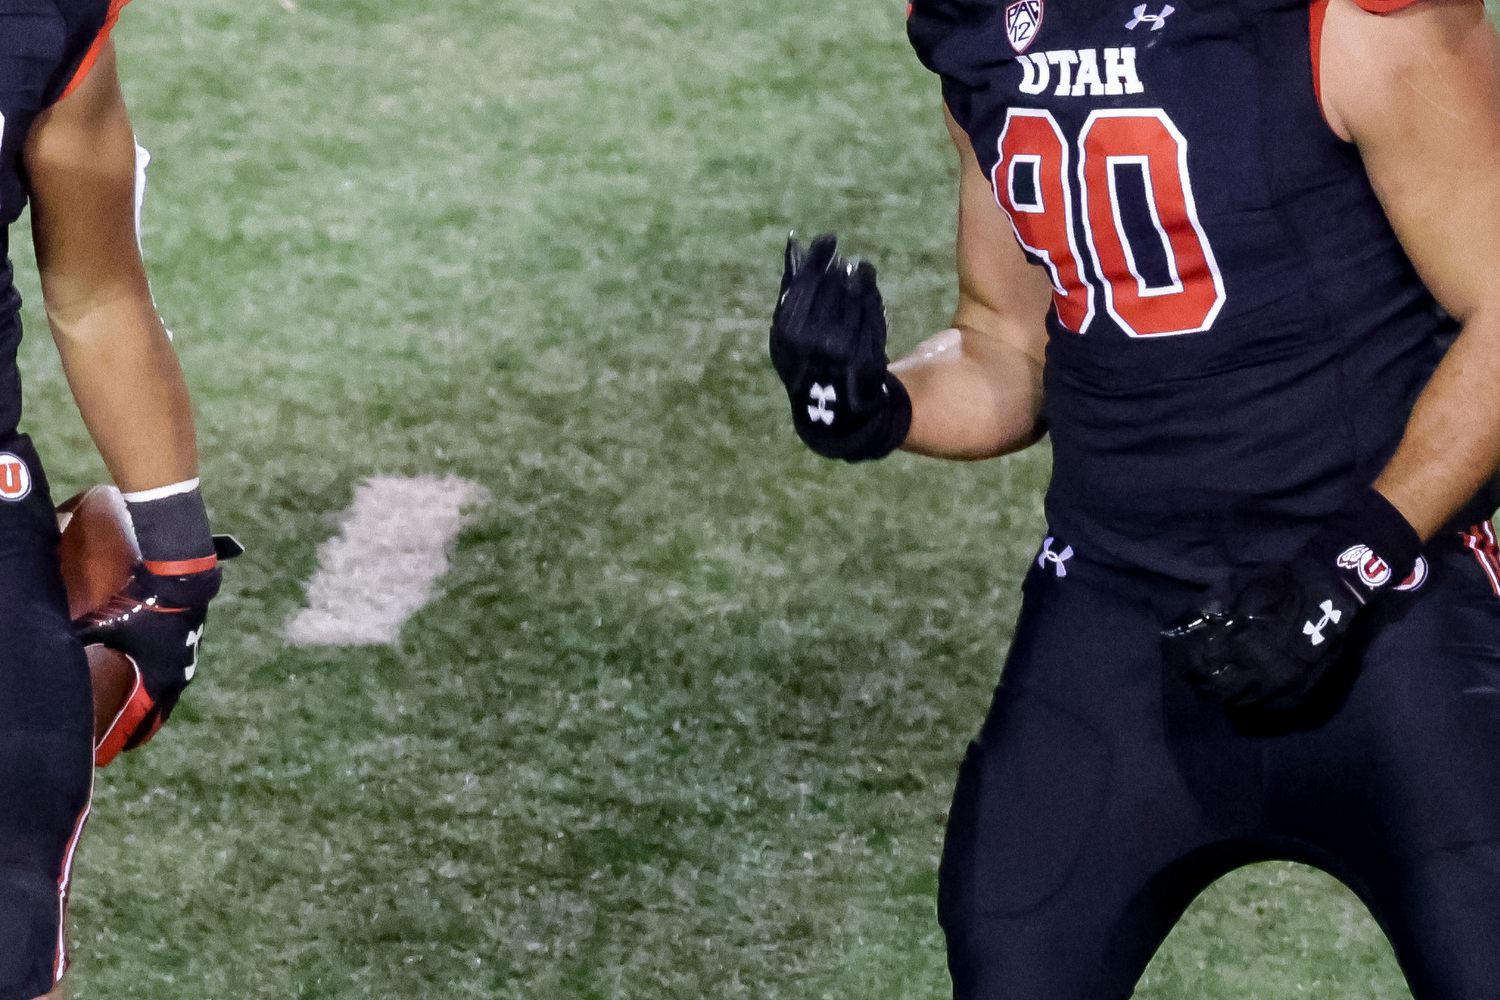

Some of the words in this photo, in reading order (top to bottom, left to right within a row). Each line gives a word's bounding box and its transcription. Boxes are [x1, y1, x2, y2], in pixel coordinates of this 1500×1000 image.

[1007, 0, 1039, 34] PAC
[1013, 22, 1031, 43] 12
[1015, 46, 1144, 96] UTAH
[990, 107, 1227, 338] 90
